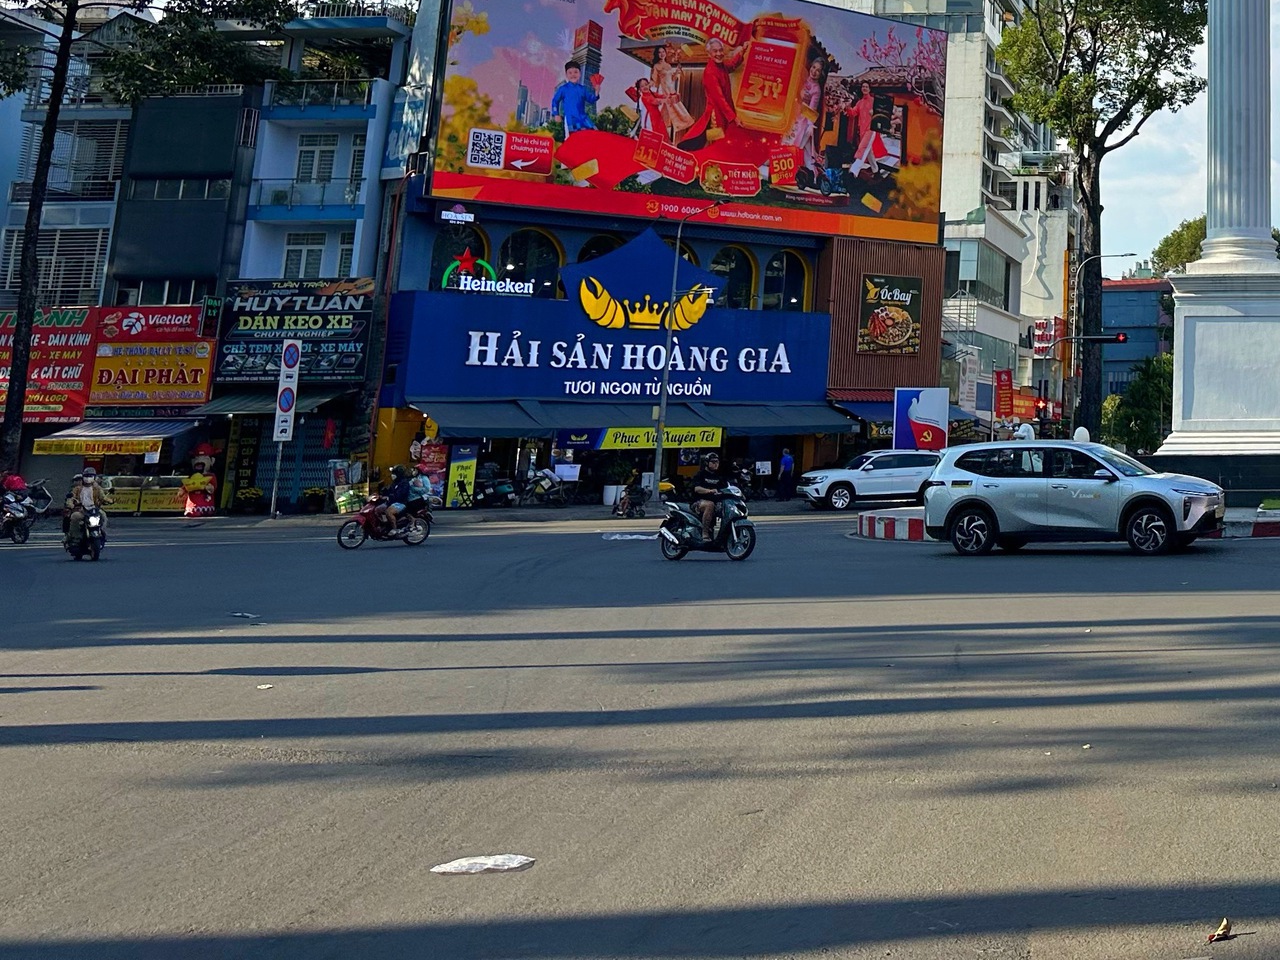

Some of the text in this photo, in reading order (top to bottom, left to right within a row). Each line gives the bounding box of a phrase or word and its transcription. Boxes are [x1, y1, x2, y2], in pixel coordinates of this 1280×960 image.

[645, 3, 669, 20] VẬN
[671, 8, 693, 23] MAY
[712, 23, 740, 46] PHÚ
[743, 74, 764, 104] 3
[772, 158, 795, 172] 500
[660, 203, 679, 213] 1900
[720, 210, 783, 222] www.hdbank.com.vn
[459, 275, 534, 294] Heineken
[893, 288, 912, 306] Bay
[148, 313, 193, 326] Vietlott
[238, 312, 354, 330] DÁN KEO XE
[48, 331, 67, 346] DÁN
[68, 330, 91, 346] KÍNH
[49, 351, 61, 360] XE
[62, 349, 82, 360] MÁY
[249, 343, 272, 354] TEM
[320, 343, 336, 352] XE
[338, 341, 364, 352] MÁY
[465, 329, 792, 374] HẢI SẢN HOÀNG GIA
[31, 361, 84, 380] & CẮT CHỮ
[97, 362, 205, 390] ĐẠI PHÁT
[564, 376, 712, 397] TƯƠI NGON TỪ NGUỒN
[45, 394, 68, 402] LOGO
[612, 429, 715, 447] Phục Vụ Xuyên Tết
[84, 443, 100, 454] ĐẠI
